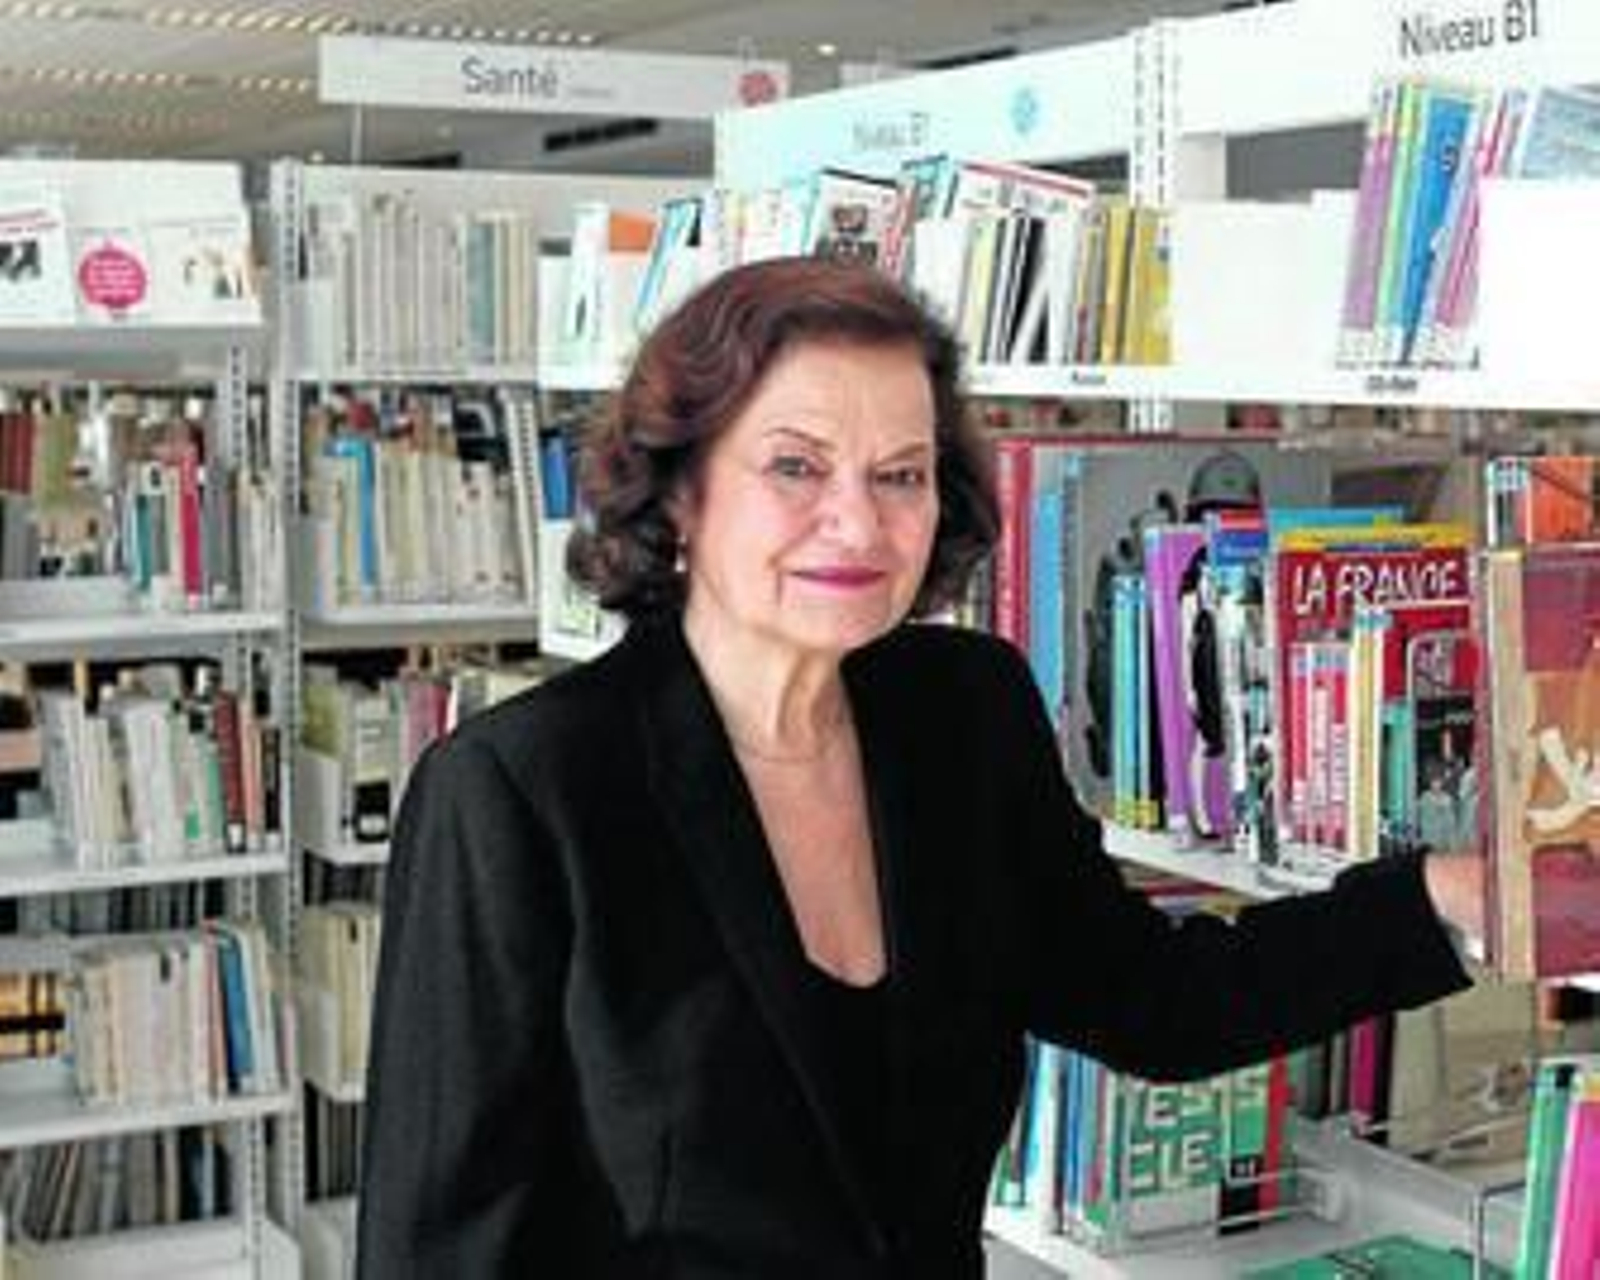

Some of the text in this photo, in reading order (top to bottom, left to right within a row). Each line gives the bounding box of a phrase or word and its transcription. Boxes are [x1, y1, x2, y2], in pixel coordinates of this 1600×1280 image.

[1399, 0, 1537, 59] Niveau B1
[460, 55, 558, 99] Santé
[1293, 562, 1326, 617] LA
